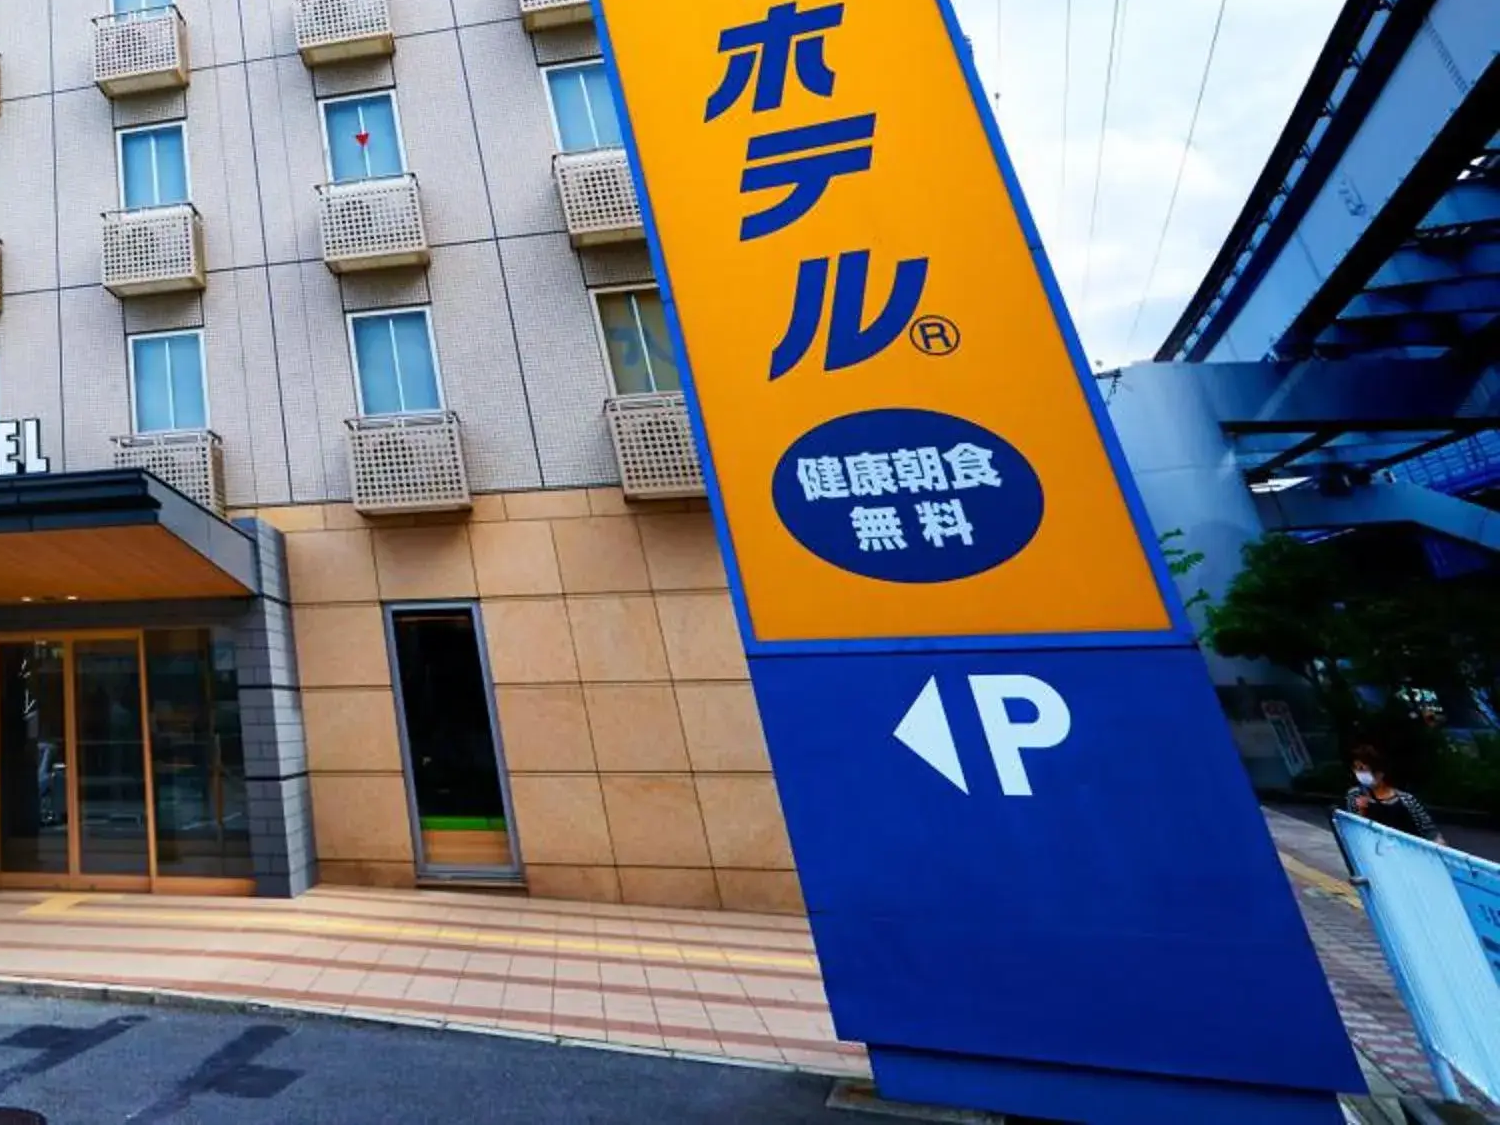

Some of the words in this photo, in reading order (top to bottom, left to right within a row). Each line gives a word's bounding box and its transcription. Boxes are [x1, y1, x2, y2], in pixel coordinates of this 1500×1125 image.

[797, 442, 1003, 503] 健康朝食
[850, 498, 975, 552] 無料
[967, 674, 1071, 796] P
